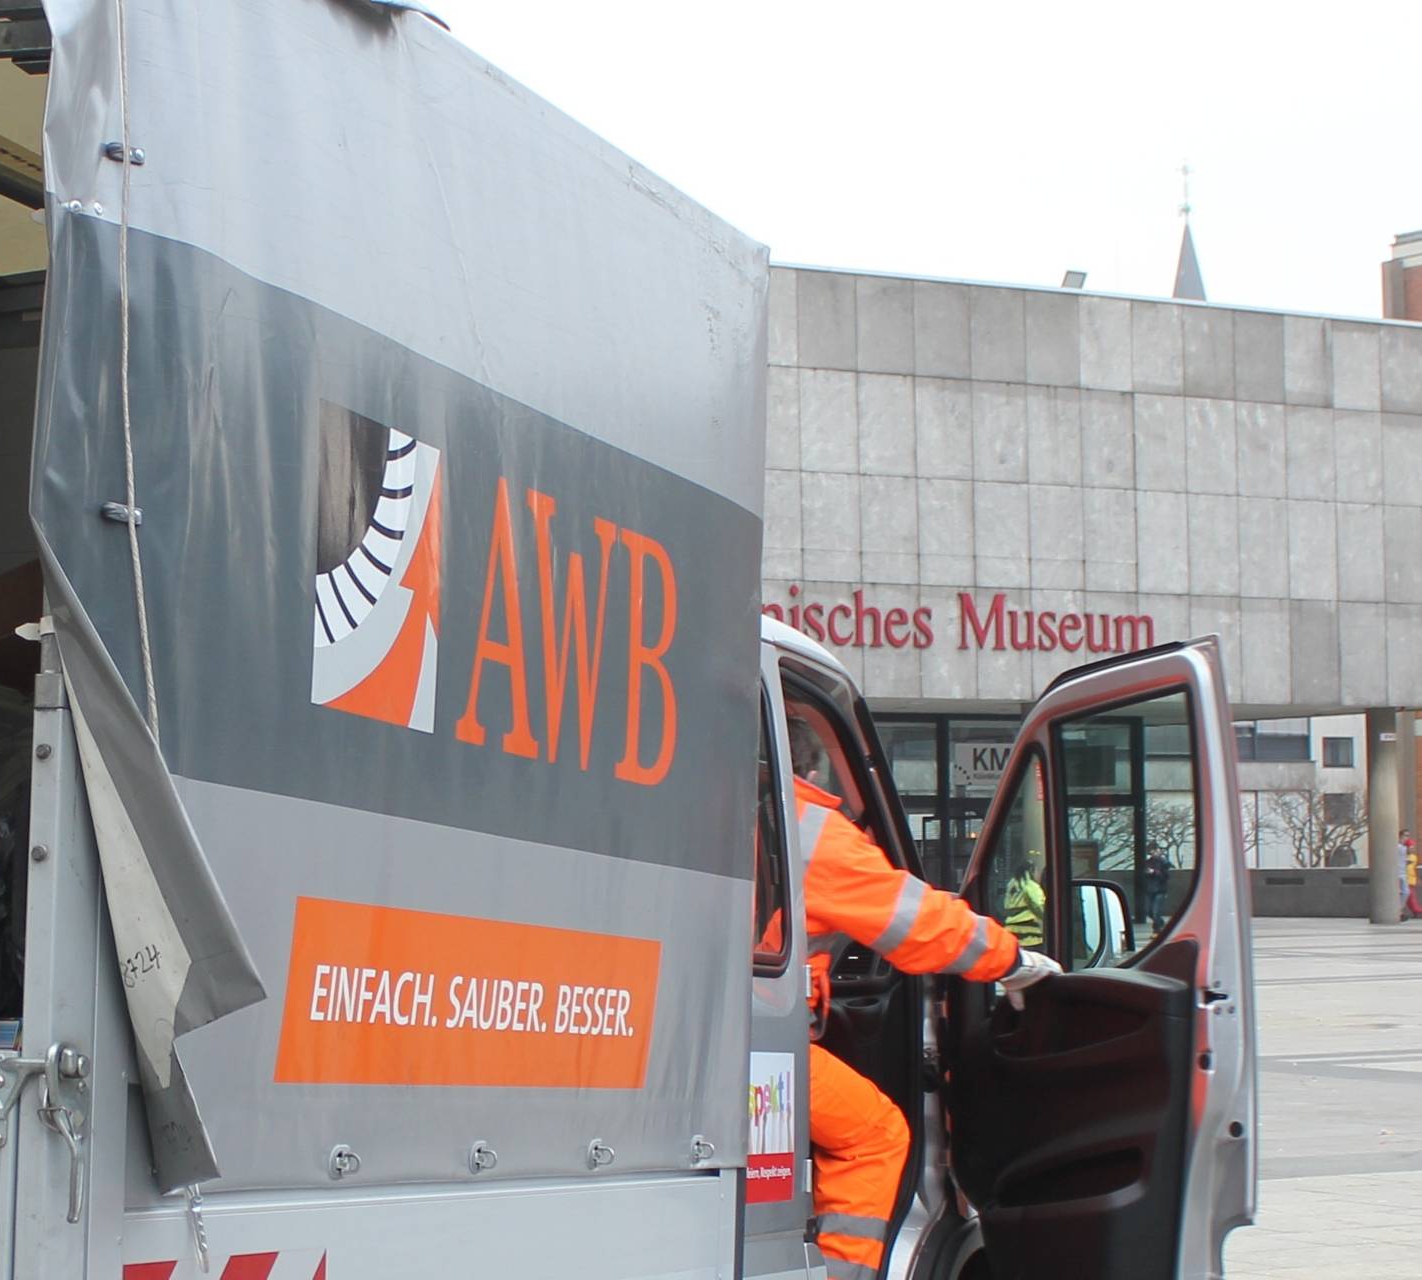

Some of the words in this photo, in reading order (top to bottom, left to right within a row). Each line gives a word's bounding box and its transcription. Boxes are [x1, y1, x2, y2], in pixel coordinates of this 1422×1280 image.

[455, 476, 678, 786] AWB
[958, 592, 1155, 652] Museum
[309, 964, 437, 1028] EINFACH.
[445, 975, 547, 1033] SAUBER.
[554, 984, 634, 1037] BESSER.
